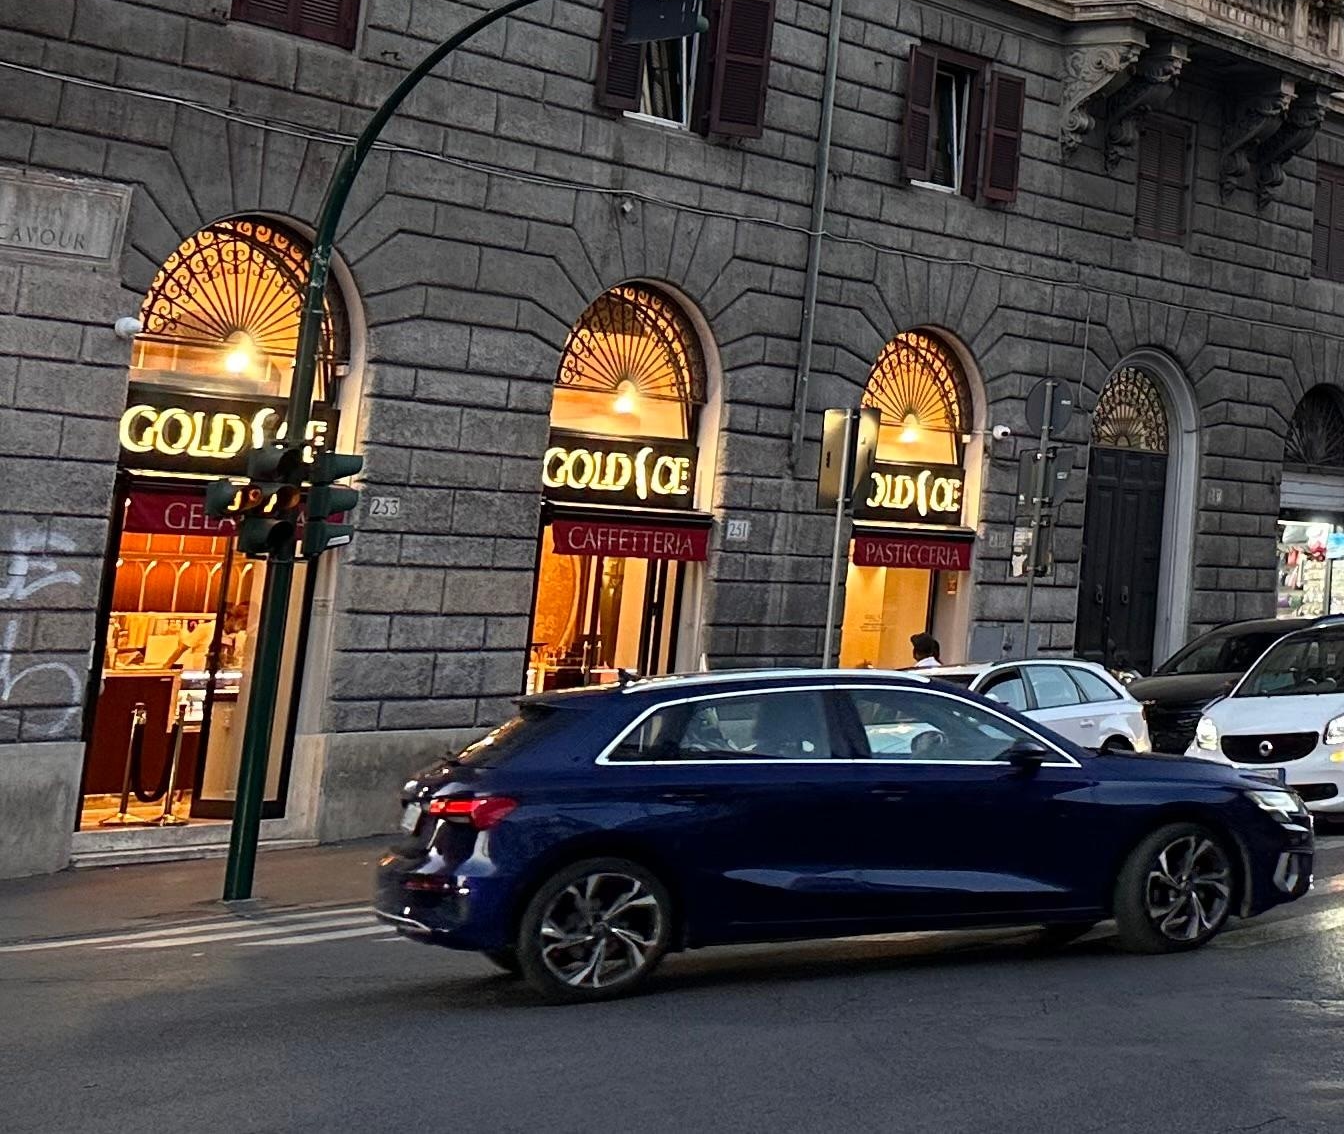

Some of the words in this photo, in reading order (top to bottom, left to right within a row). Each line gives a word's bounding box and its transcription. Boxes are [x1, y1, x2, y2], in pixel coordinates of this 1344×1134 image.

[370, 498, 399, 516] 253
[568, 526, 694, 556] CAFFETTERIA
[866, 543, 960, 566] PASTICCERIA
